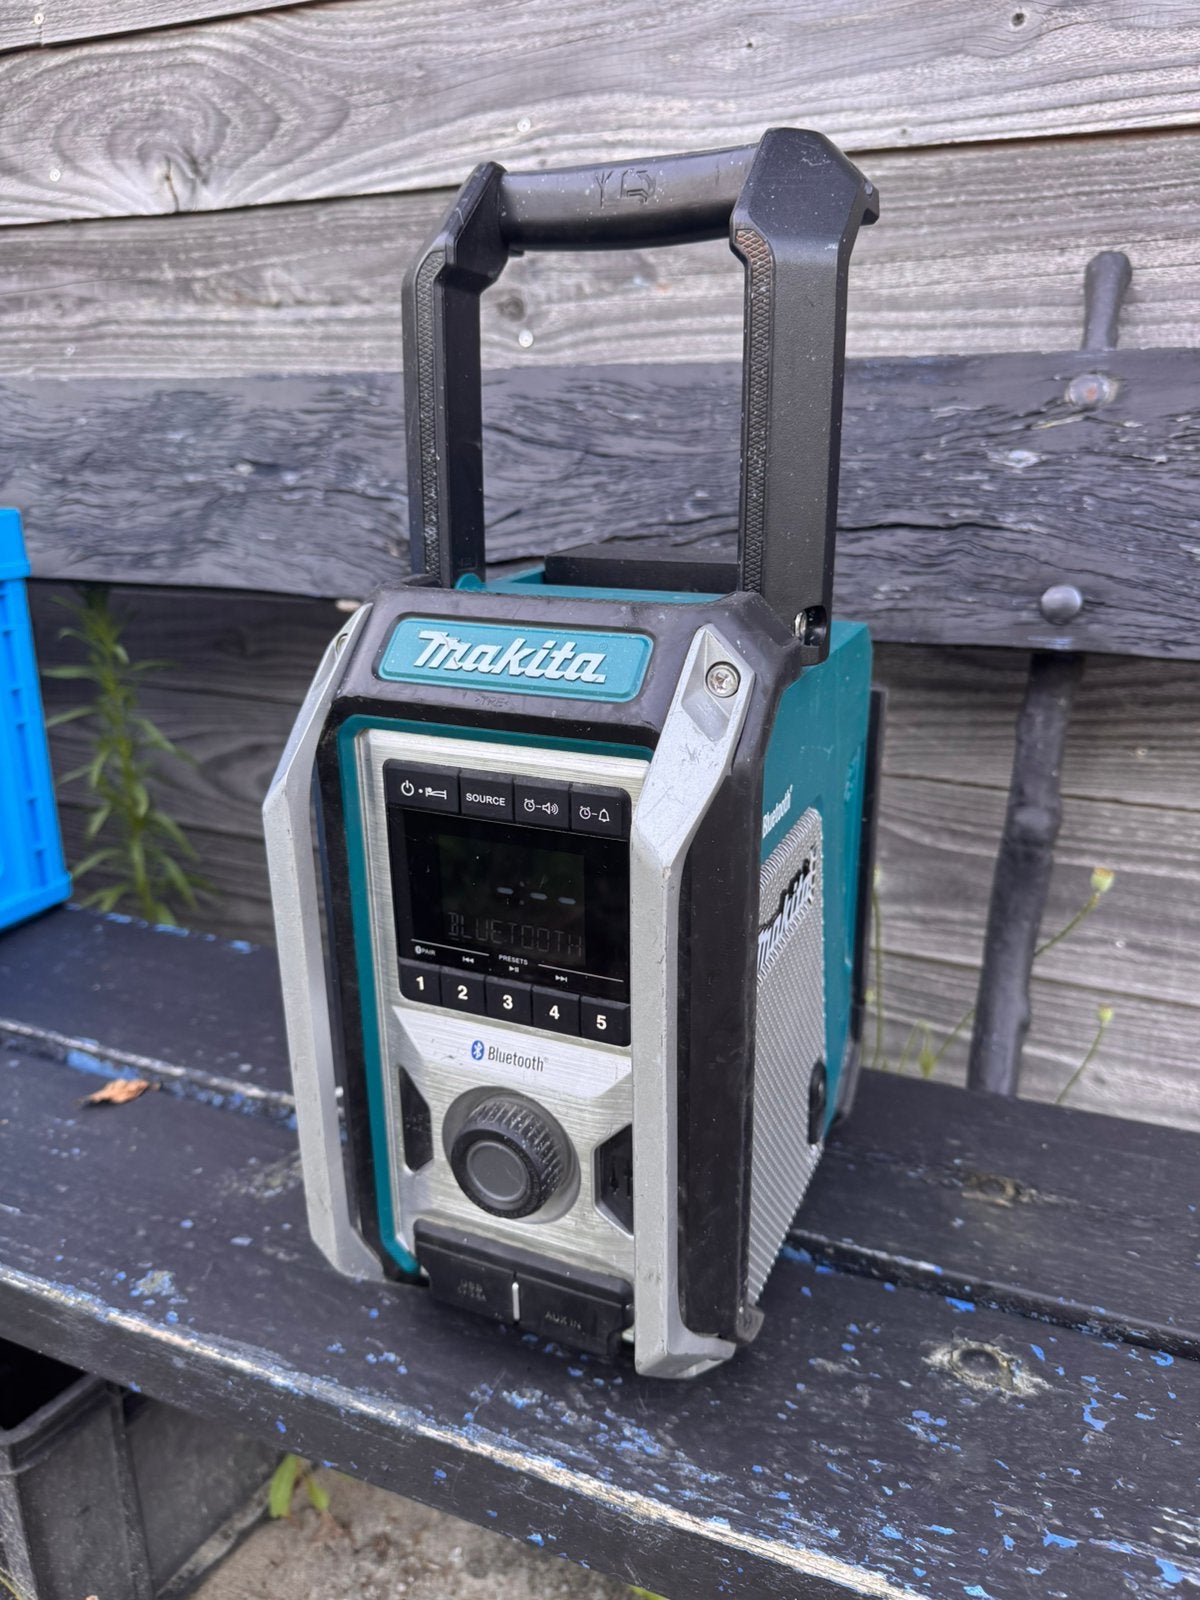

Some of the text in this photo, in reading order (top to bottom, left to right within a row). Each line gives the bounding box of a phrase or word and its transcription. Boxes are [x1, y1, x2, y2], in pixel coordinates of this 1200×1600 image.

[465, 792, 506, 806] SOURCE
[447, 911, 583, 959] BLUETOOTH
[421, 946, 437, 957] PAIR
[497, 953, 529, 966] PRESETS
[415, 975, 608, 1031] 1 2 3 4 5
[487, 1045, 545, 1072] Bluetooth
